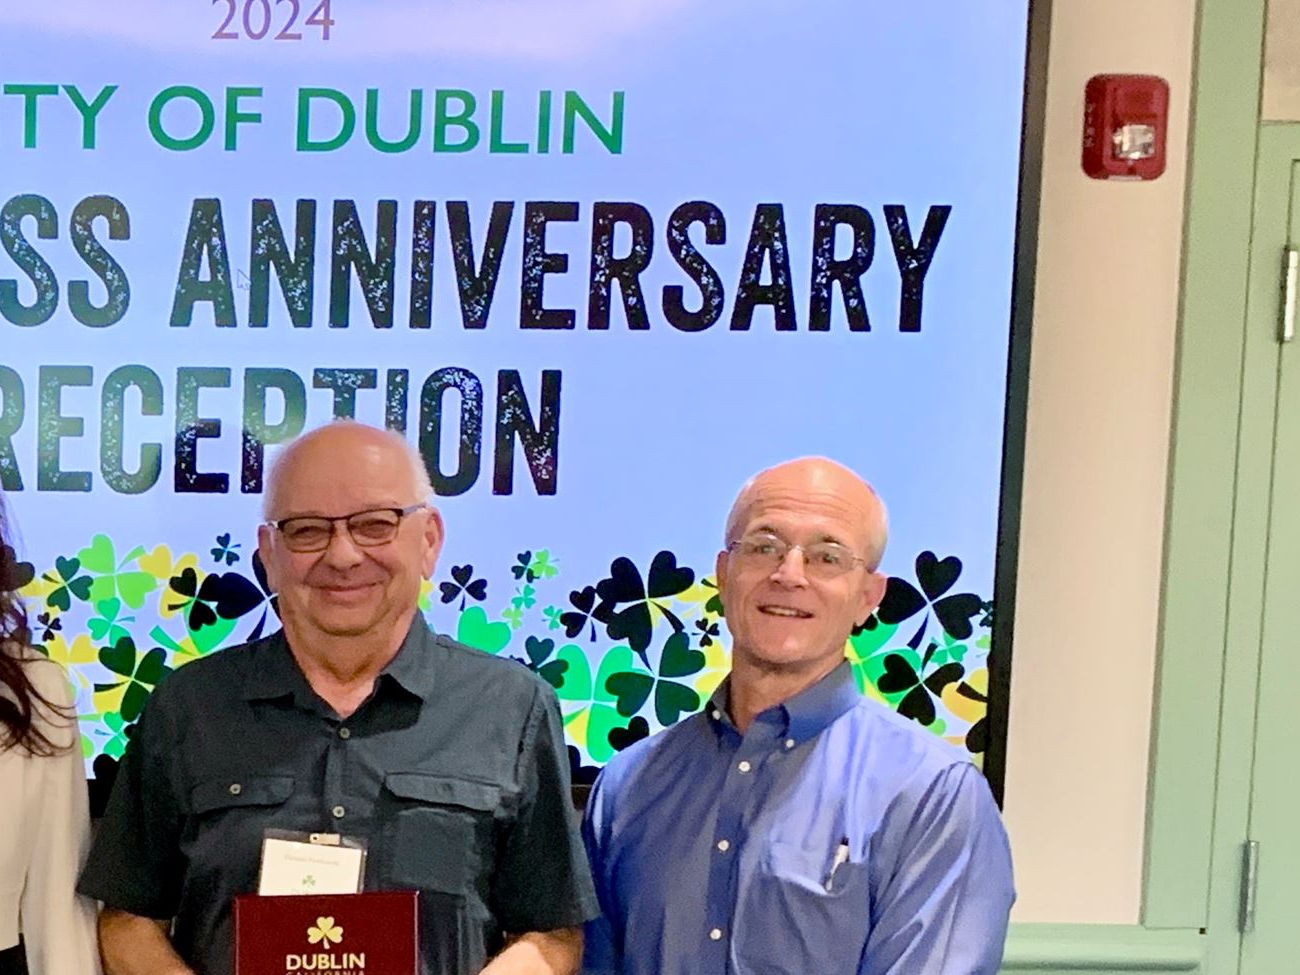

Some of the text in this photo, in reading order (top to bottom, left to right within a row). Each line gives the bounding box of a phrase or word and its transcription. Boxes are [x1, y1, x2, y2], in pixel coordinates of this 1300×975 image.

[211, 0, 335, 41] 2024
[149, 86, 263, 152] OF
[297, 88, 625, 155] DUBLIN
[170, 198, 953, 332] ANNIVERSARY
[286, 952, 366, 970] DUBLIN
